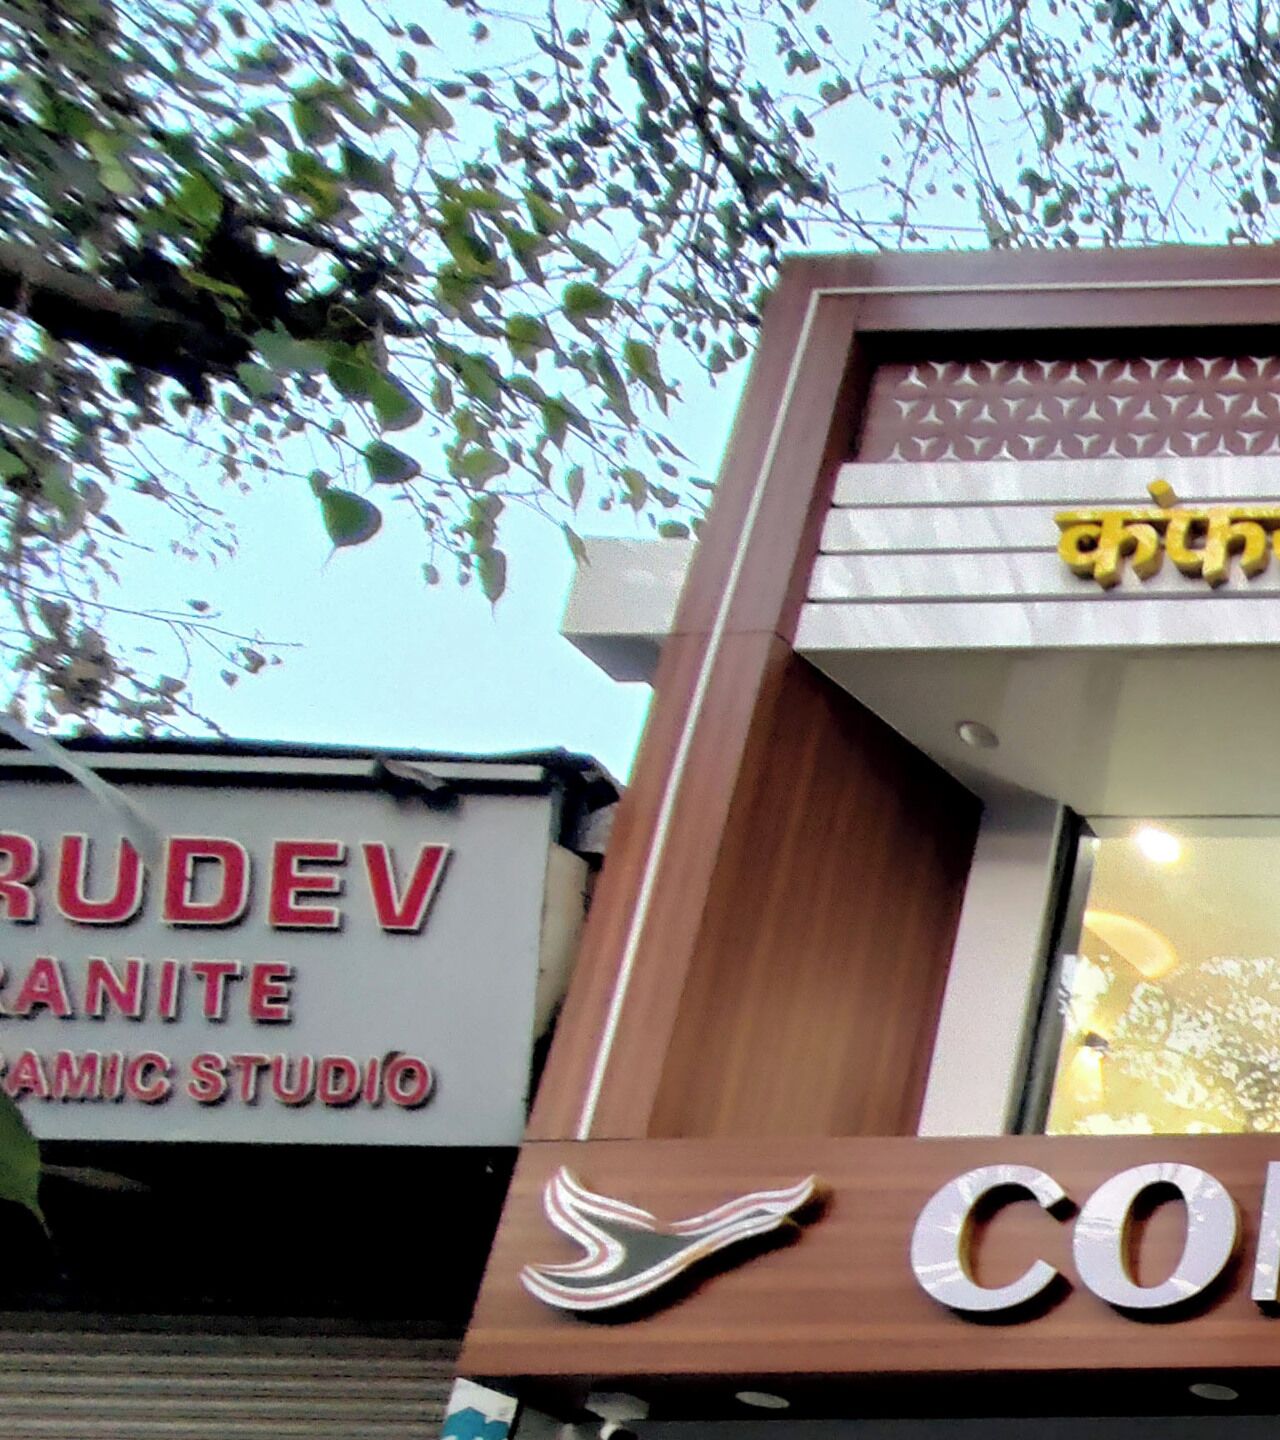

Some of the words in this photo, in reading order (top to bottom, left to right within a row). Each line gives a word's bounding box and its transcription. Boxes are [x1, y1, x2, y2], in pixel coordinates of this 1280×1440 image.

[0, 955, 296, 1022] ANITE
[0, 1050, 174, 1104] AMIC
[187, 1050, 435, 1109] STUDIO
